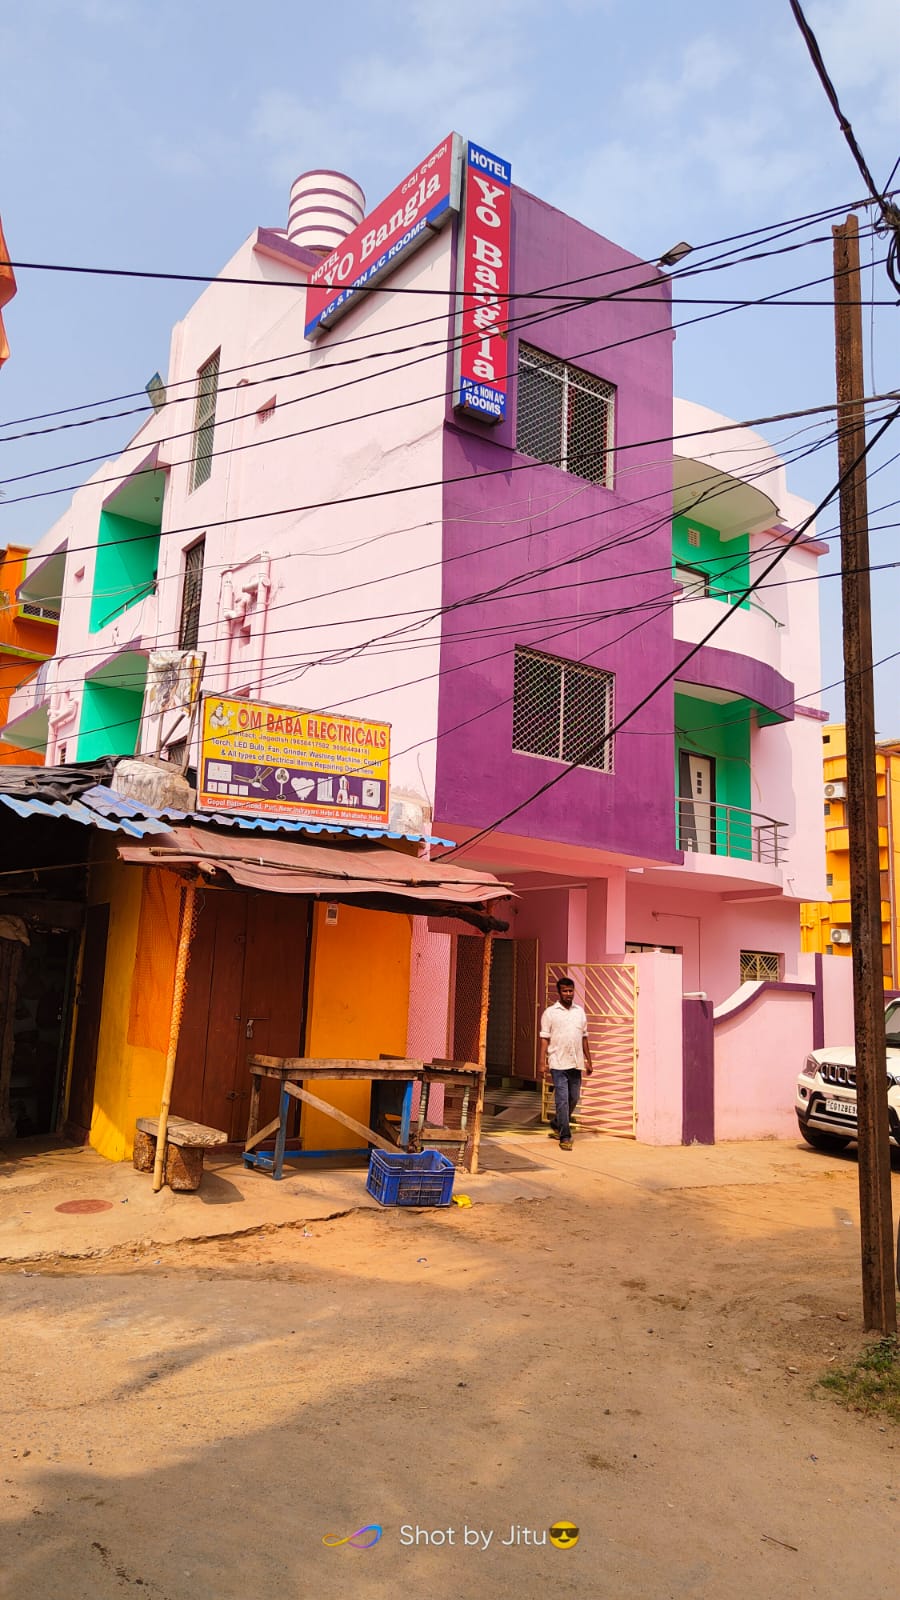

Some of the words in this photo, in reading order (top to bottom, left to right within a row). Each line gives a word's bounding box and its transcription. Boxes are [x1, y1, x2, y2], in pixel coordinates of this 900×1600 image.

[470, 148, 508, 180] HOTEL
[359, 174, 441, 263] Bangla
[311, 252, 339, 283] HOTEL
[320, 302, 335, 322] A/C
[336, 294, 344, 306] &
[346, 271, 368, 298] NON
[369, 256, 386, 276] A/C
[388, 217, 428, 256] ROOMS
[472, 234, 503, 384] Bangla
[466, 392, 501, 415] ROOMS
[474, 386, 479, 395] &
[480, 386, 494, 401] NON
[238, 708, 262, 730] OM
[266, 713, 303, 736] BABA
[307, 720, 386, 750] ELECTRICALS
[234, 740, 248, 748] LED
[310, 751, 335, 761] Washing
[238, 752, 256, 760] types
[266, 755, 296, 766] Electrical
[314, 762, 344, 772] Repairing
